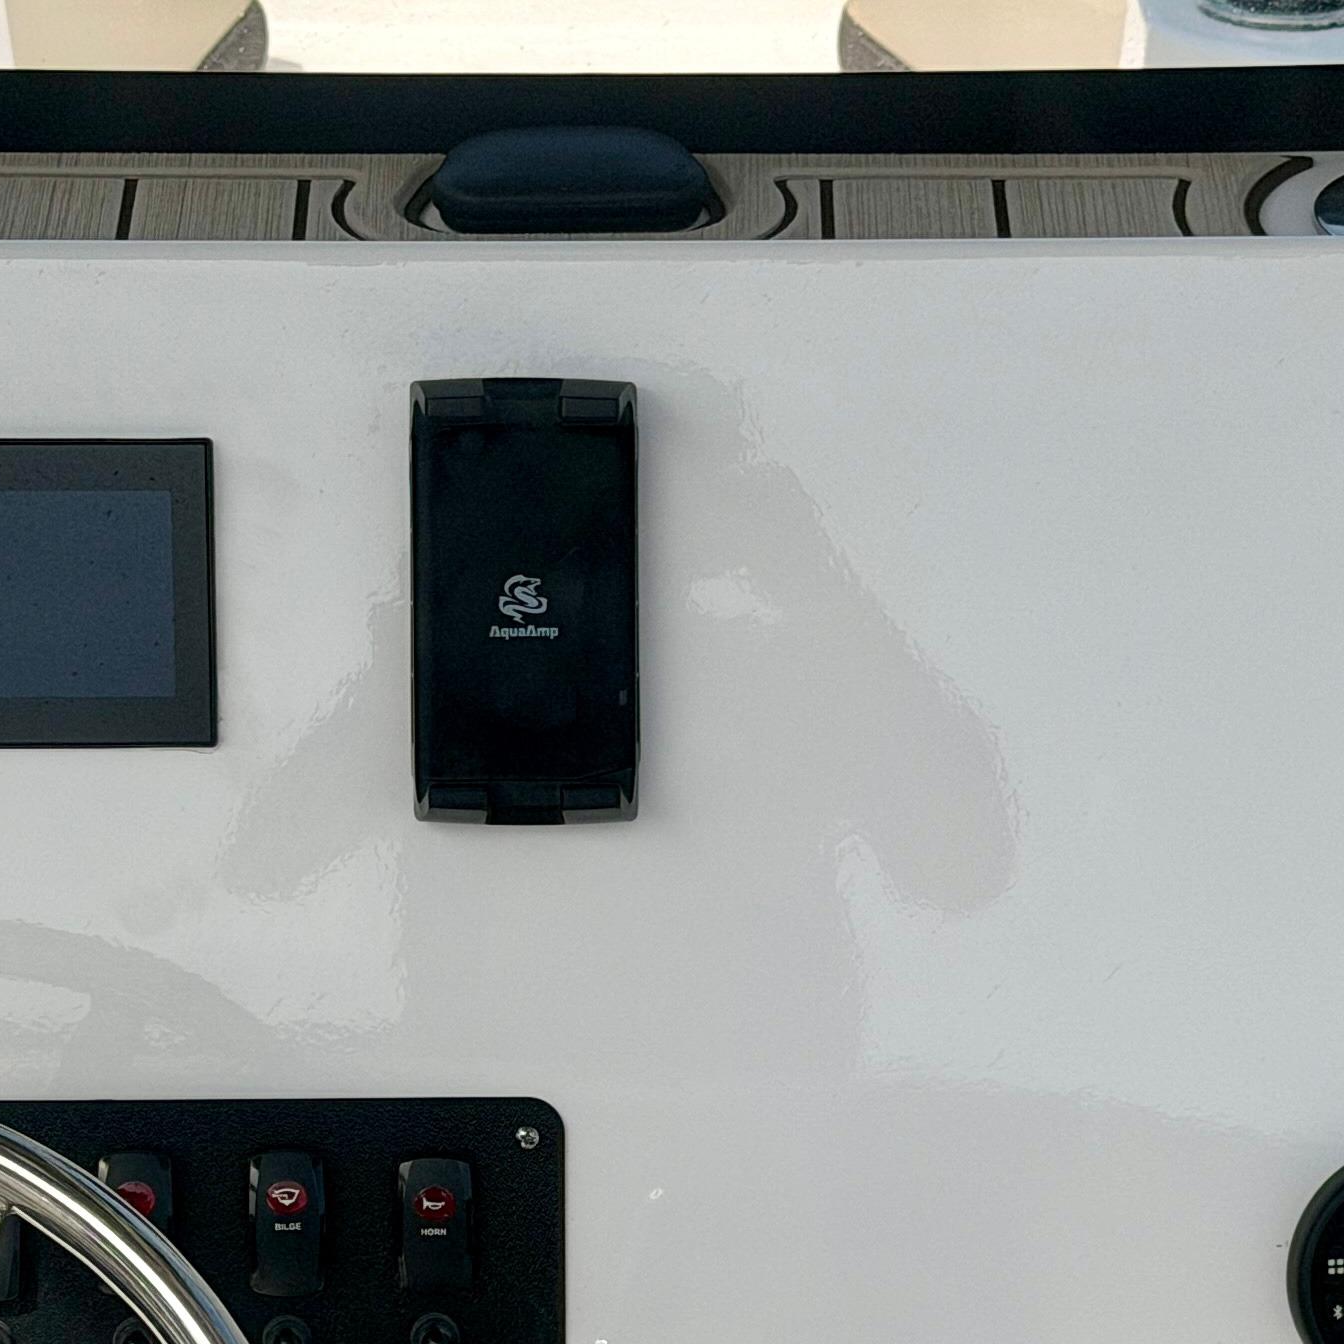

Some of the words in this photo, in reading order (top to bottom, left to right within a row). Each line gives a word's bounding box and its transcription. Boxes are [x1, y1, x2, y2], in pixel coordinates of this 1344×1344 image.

[489, 625, 559, 640] AquaAmp
[274, 1222, 302, 1231] BILGE
[421, 1228, 447, 1236] HORN
